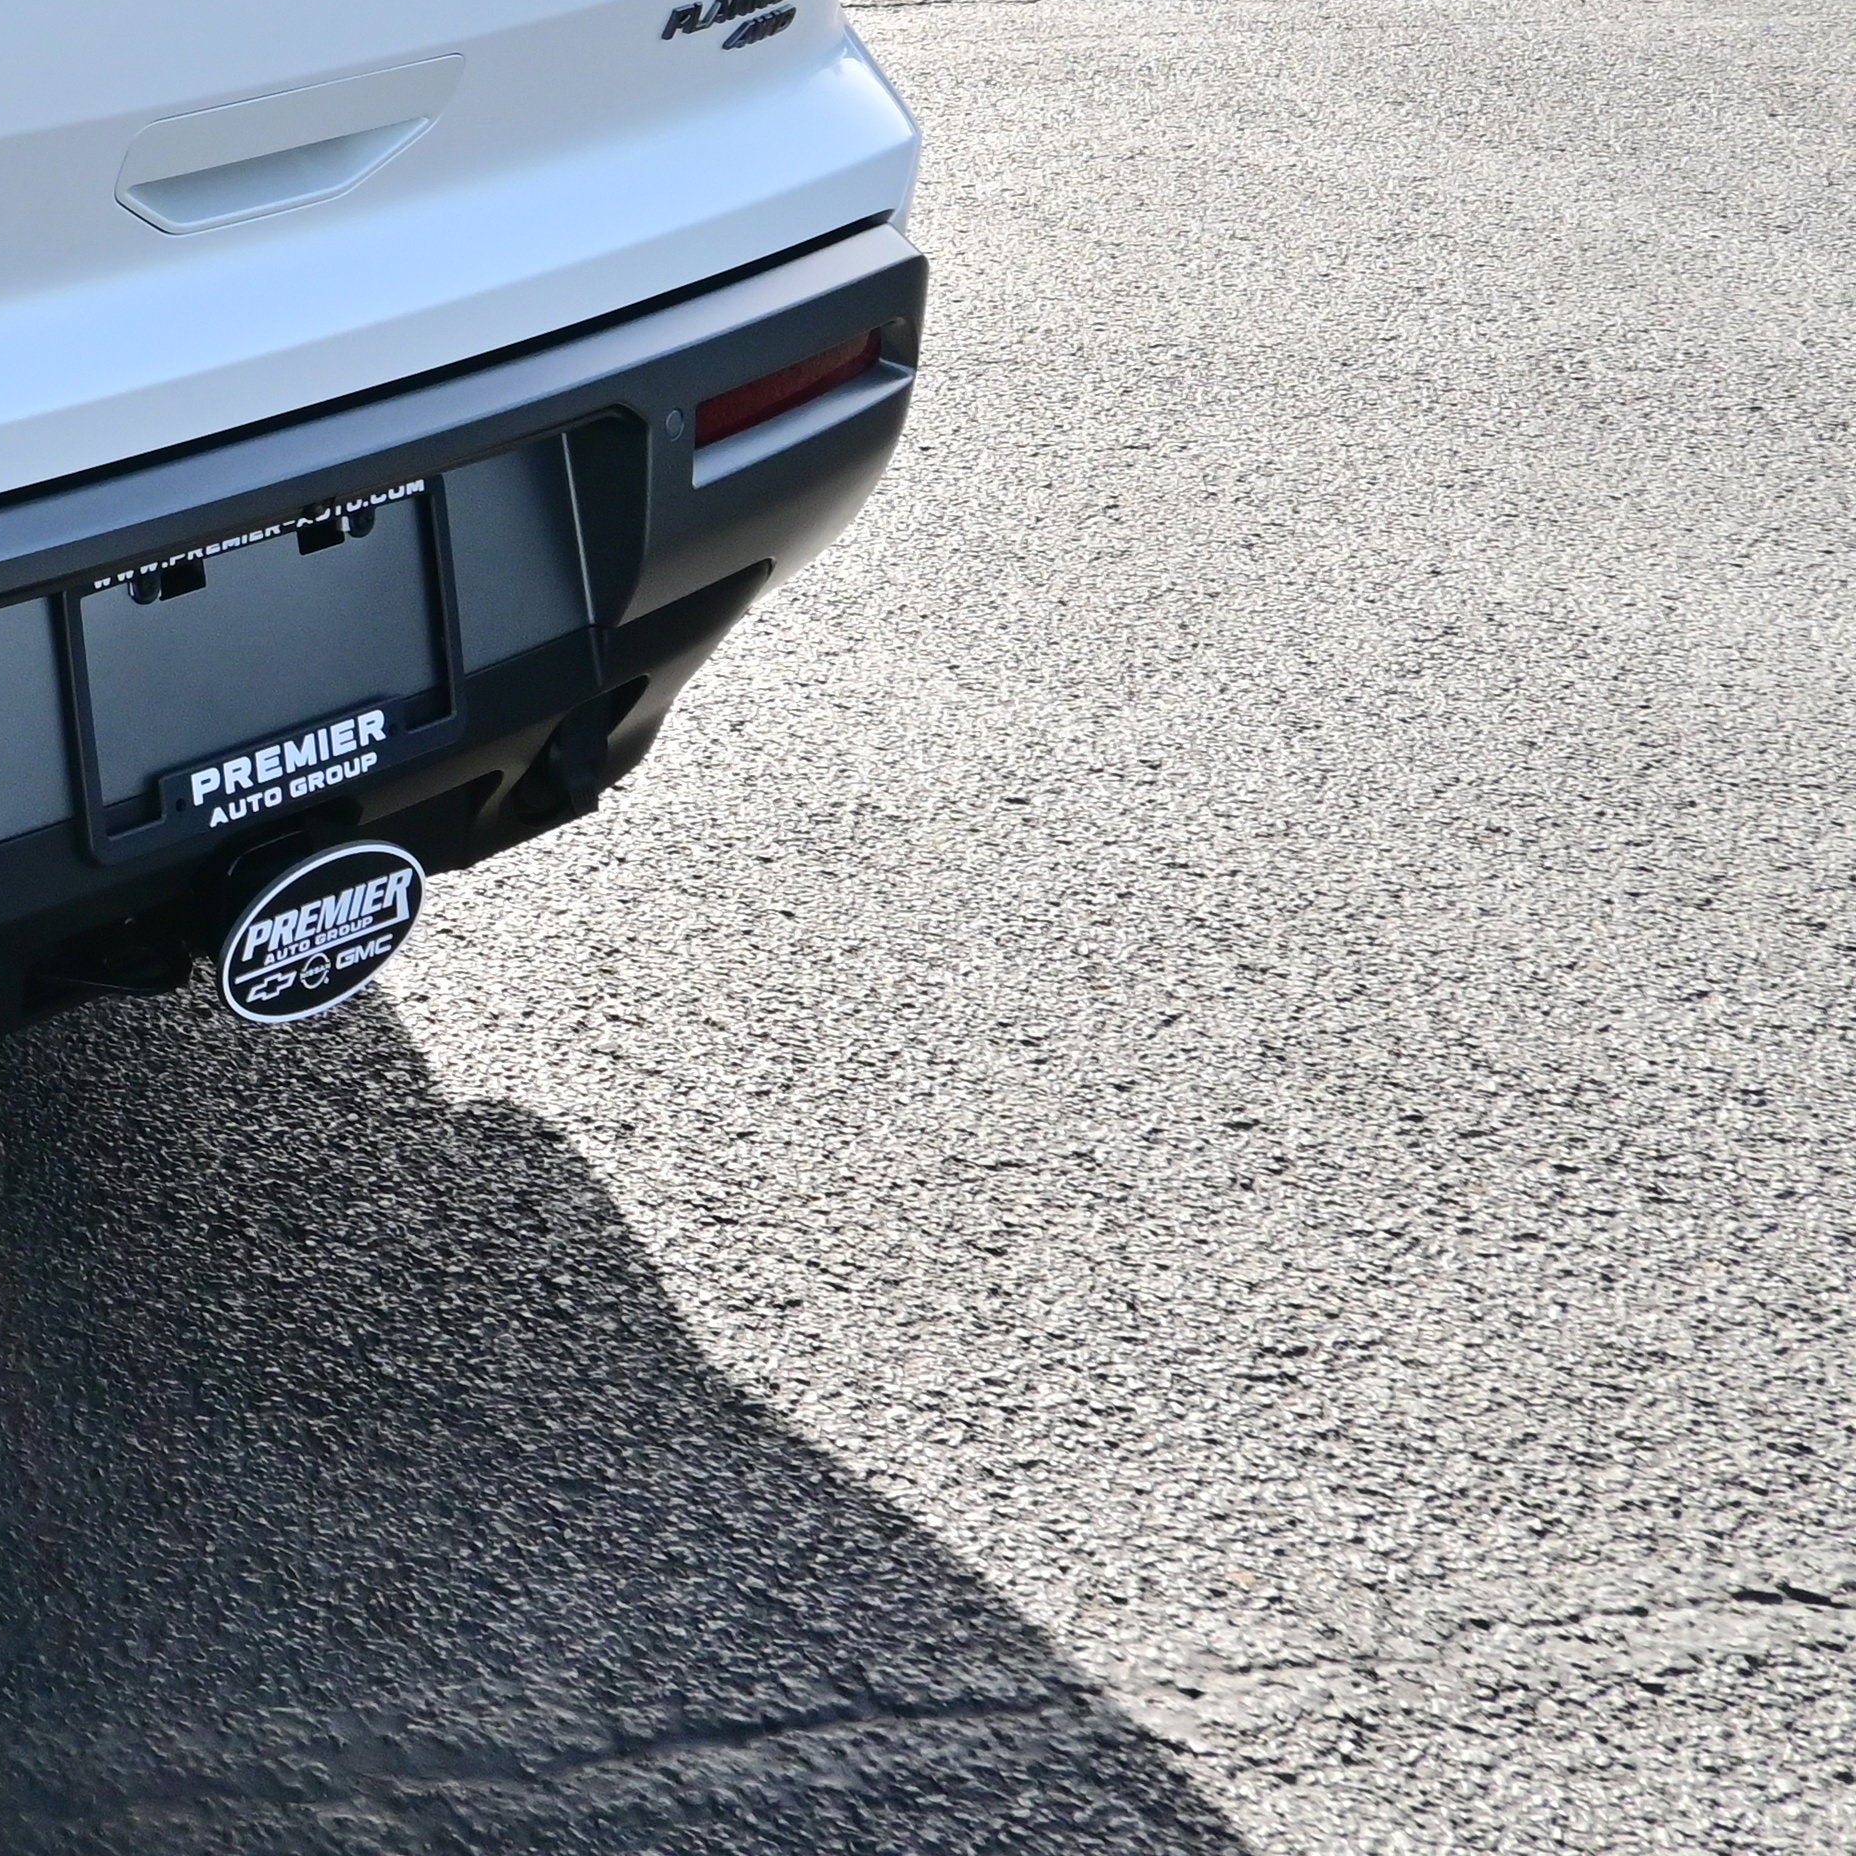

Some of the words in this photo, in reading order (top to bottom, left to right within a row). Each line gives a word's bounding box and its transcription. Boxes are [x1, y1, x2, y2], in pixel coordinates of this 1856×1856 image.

[190, 708, 387, 807] PREMIER
[209, 786, 283, 828] AUTO
[289, 751, 378, 798] GROUP
[241, 868, 414, 962] PREMIER
[264, 939, 311, 966] AUTO
[315, 916, 374, 946] GROUP
[335, 934, 394, 970] GMC
